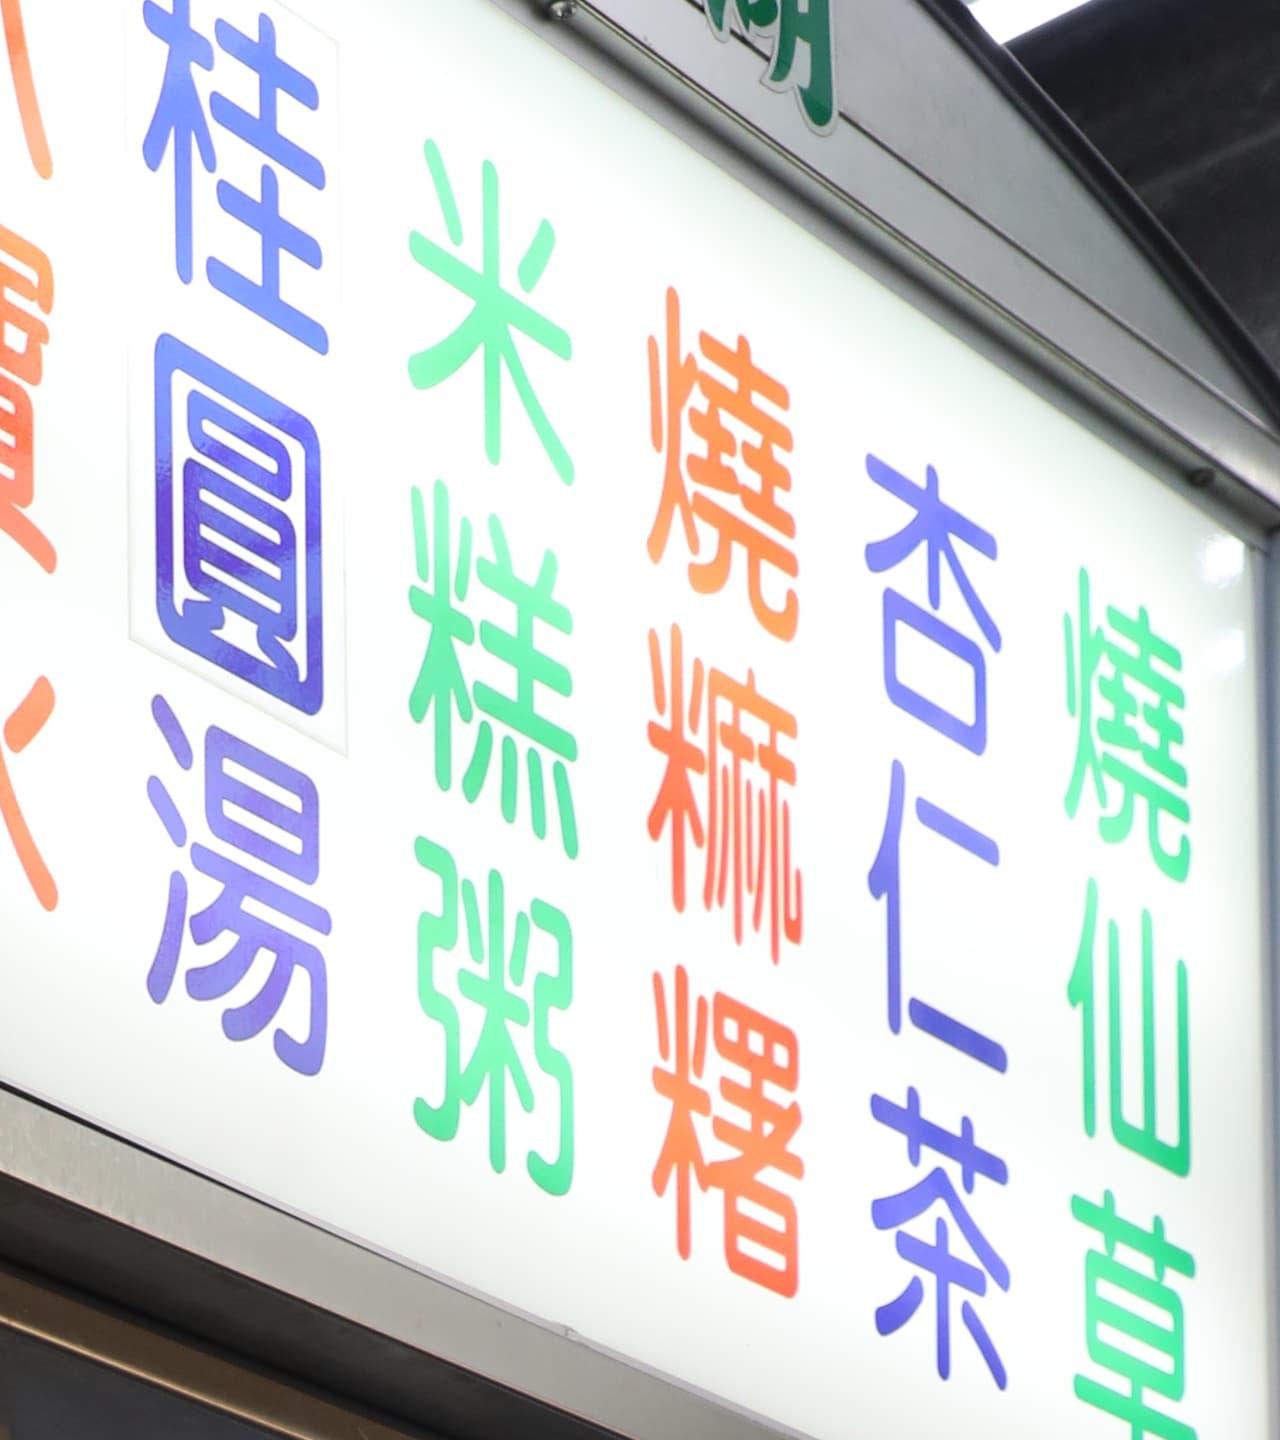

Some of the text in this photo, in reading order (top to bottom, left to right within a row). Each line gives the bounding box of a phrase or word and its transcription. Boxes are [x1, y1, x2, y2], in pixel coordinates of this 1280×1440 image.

[141, 0, 333, 1077] 桂圓湯
[407, 138, 580, 1197] 米糕粥
[863, 452, 1012, 1392] 杏仁茶
